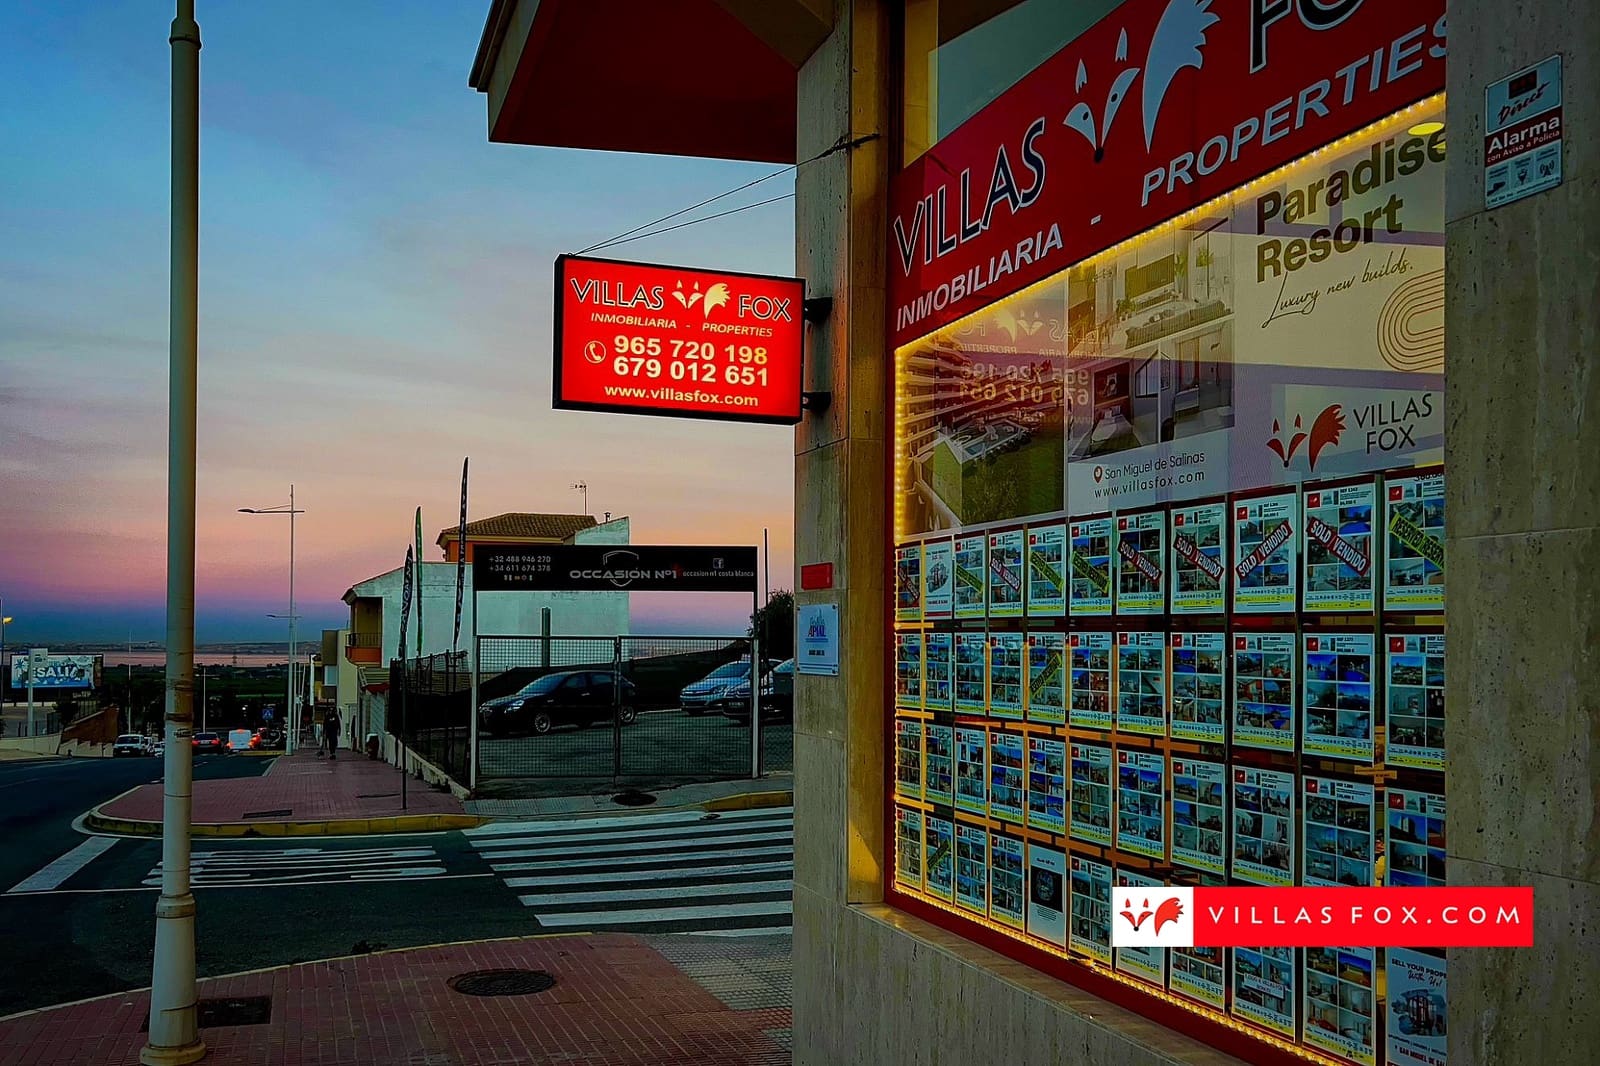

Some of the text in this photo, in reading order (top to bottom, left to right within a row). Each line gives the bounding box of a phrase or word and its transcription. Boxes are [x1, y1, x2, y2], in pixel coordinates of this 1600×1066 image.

[1487, 154, 1500, 162] con
[1503, 144, 1525, 156] Aviso
[1488, 117, 1560, 154] Alarma
[893, 116, 1046, 277] VILLAS
[1257, 127, 1446, 235] Paradise
[1257, 194, 1403, 283] Resort
[897, 222, 1064, 332] INMOBILIARIA
[1262, 247, 1413, 329] Luxury new builds.
[570, 277, 792, 322] VILLAS FOX
[591, 313, 677, 329] INMOBILIARIA
[702, 322, 773, 337] PROPERTIES
[614, 335, 768, 365] 965 720 198
[613, 356, 768, 386] 679 012 651
[604, 386, 759, 407] www.villasfox.com
[1353, 393, 1432, 428] VILLAS
[1367, 424, 1415, 454] FOX
[1105, 452, 1205, 480] San Miguel de Salinas
[1094, 471, 1205, 498] www.villasfox.com
[521, 555, 536, 563] 946
[537, 555, 551, 563] 270
[1120, 540, 1135, 559] SOLD
[1136, 554, 1160, 581] VENDIDO
[1176, 536, 1193, 556] SOLD
[1194, 551, 1221, 578] VENDIDO
[1238, 554, 1257, 578] SOLD
[1259, 524, 1289, 557] VENDIDO
[1310, 519, 1331, 543] SOLD
[1334, 538, 1367, 572] VENDIDO
[569, 568, 651, 579] OCCASIÓN
[1392, 958, 1406, 968] SELL
[1407, 962, 1425, 972] YOUR
